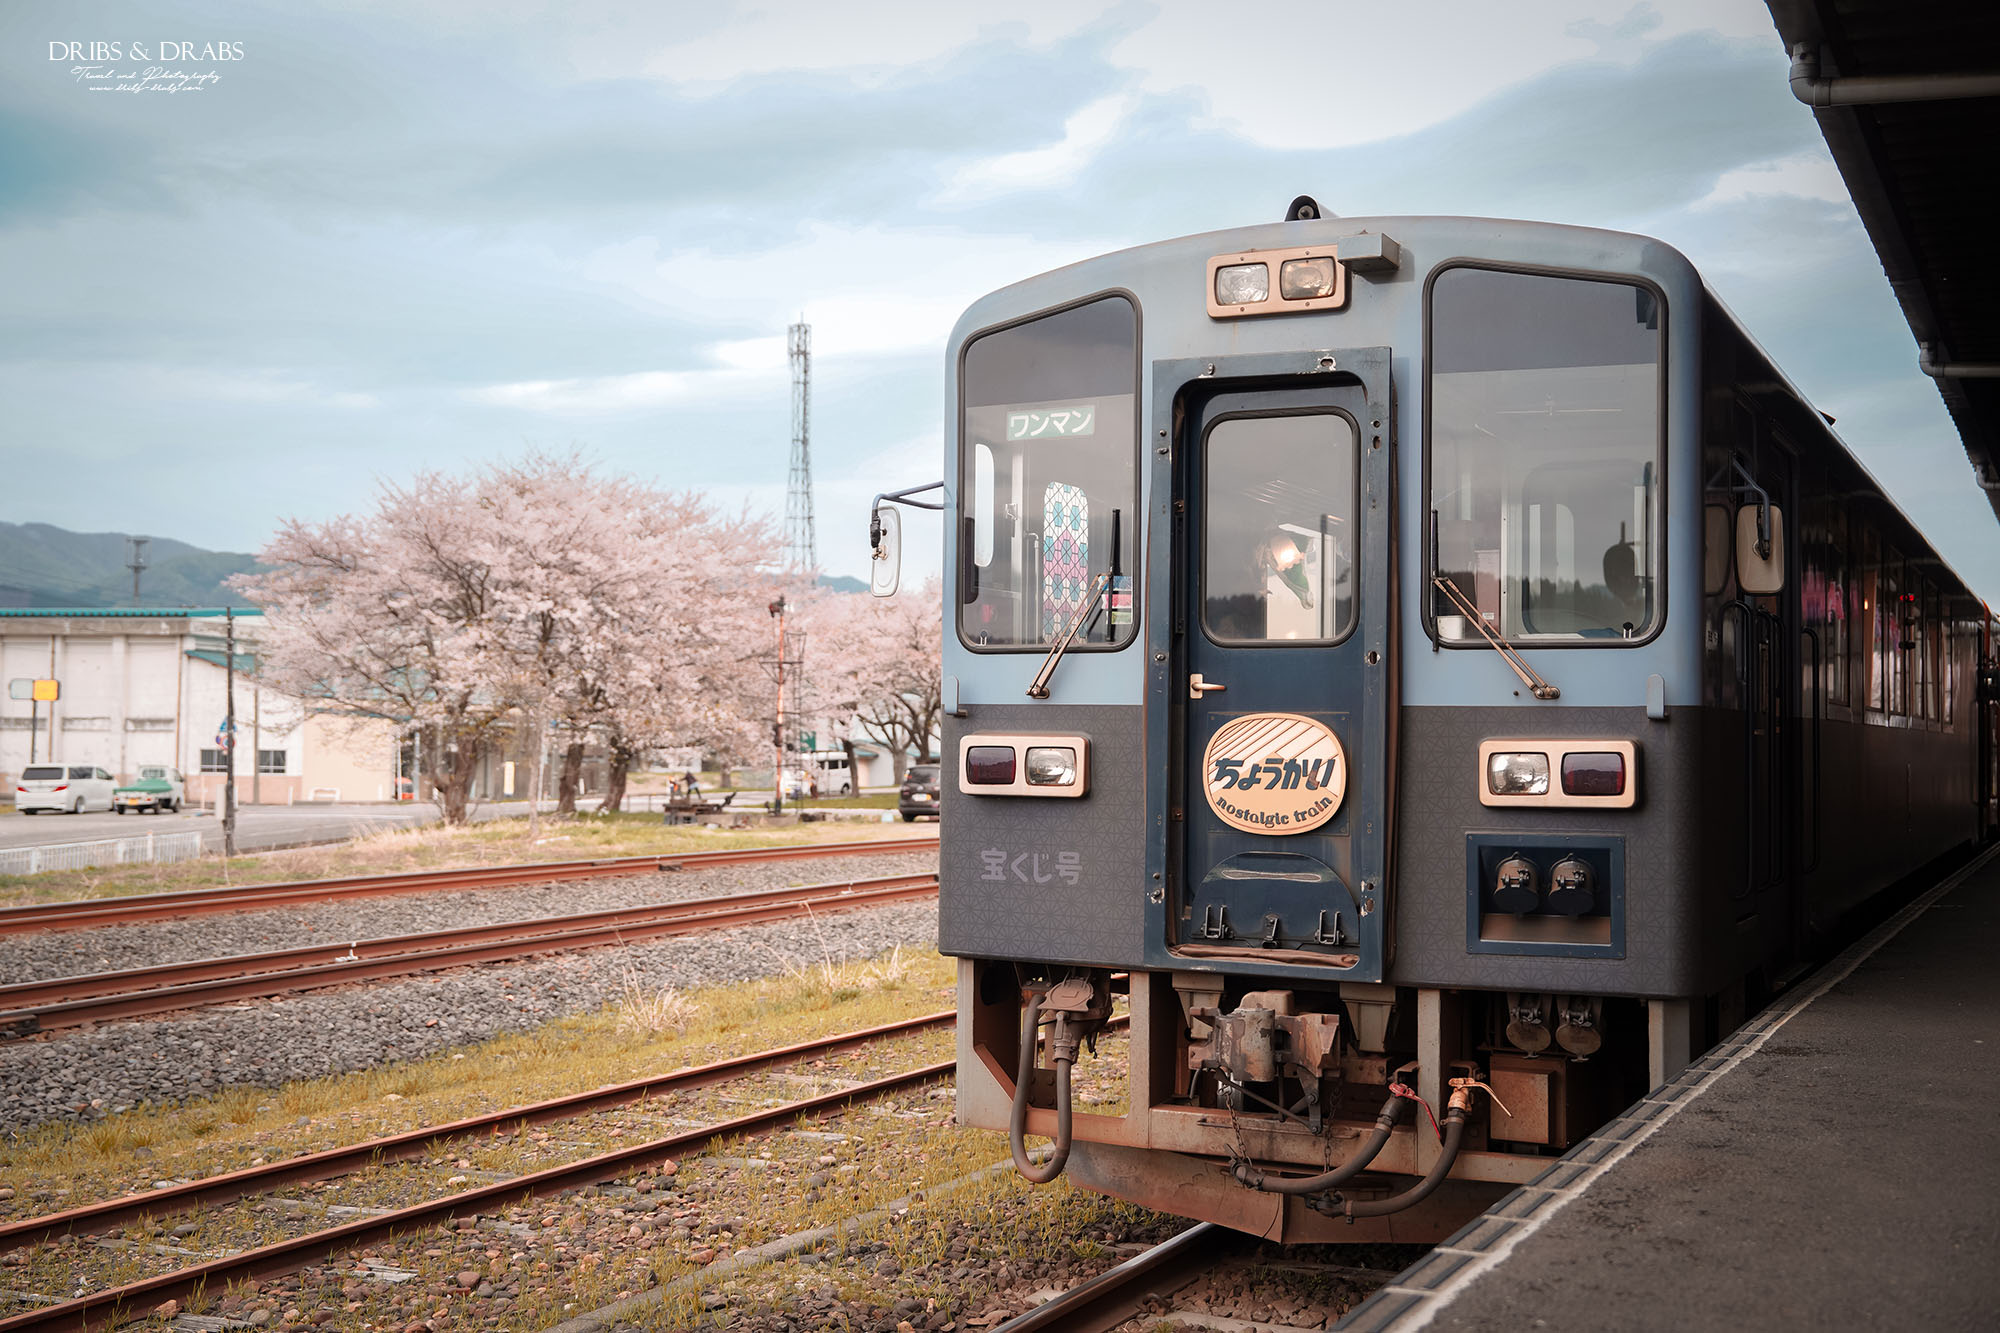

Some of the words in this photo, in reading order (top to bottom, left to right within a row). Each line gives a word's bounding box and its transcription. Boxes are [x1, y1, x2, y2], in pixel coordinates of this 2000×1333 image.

[1010, 410, 1092, 438] ワンマン
[1214, 757, 1336, 791] ちょうかい
[1216, 796, 1290, 829] nostalgic
[1293, 796, 1333, 823] train
[980, 847, 1083, 886] 宝くじ号
